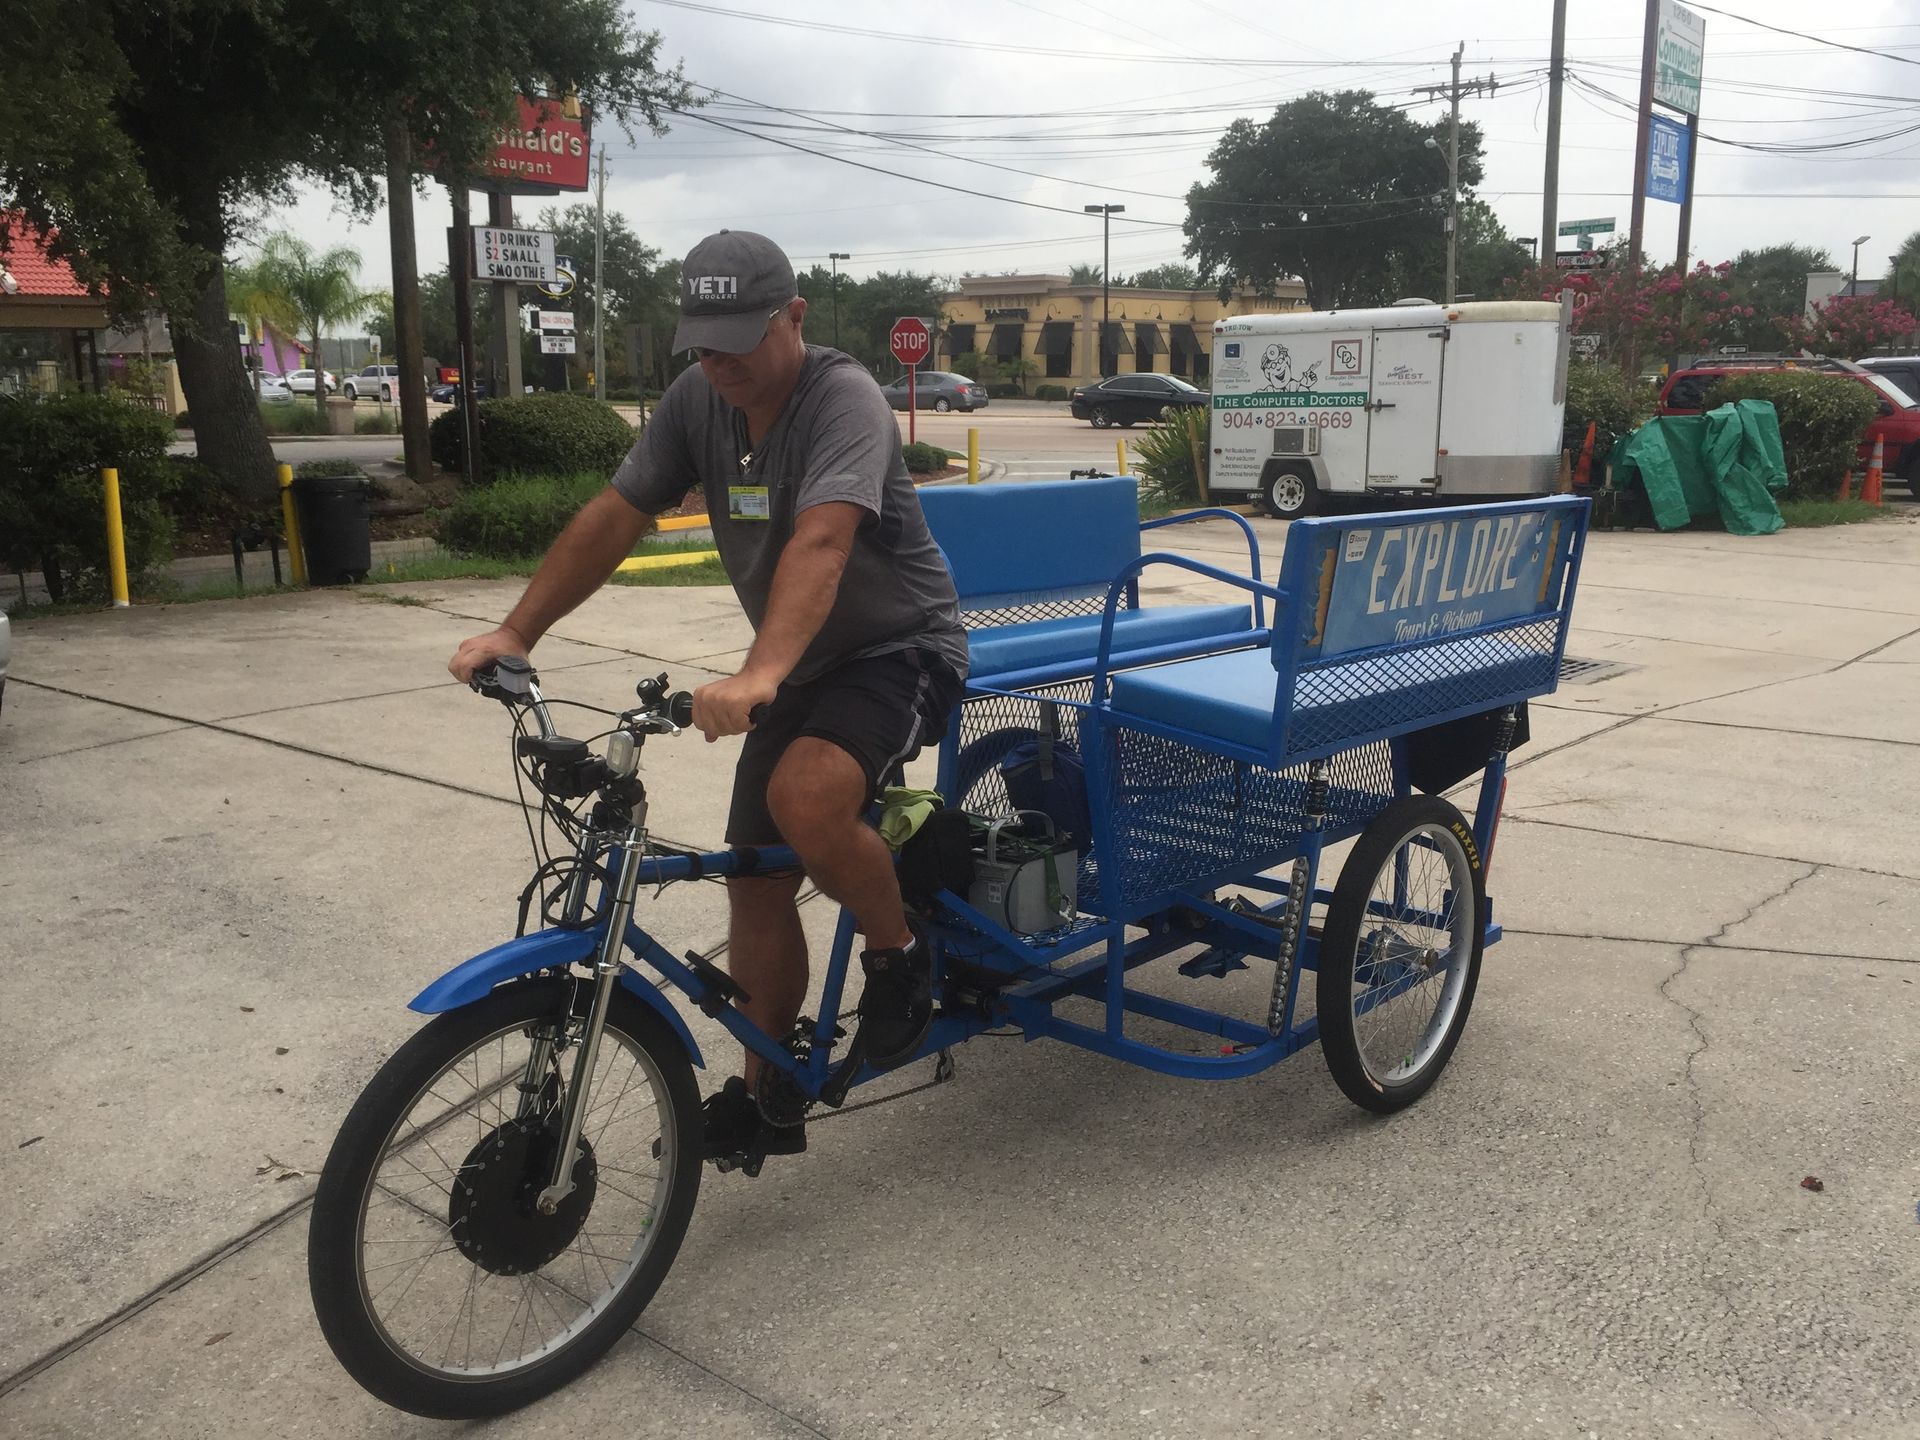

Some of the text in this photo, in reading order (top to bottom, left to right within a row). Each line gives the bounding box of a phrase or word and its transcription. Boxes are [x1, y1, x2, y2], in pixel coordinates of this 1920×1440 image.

[1658, 27, 1700, 76] Computer
[1664, 68, 1698, 112] Doctors
[500, 232, 540, 248] DRINKS
[502, 248, 540, 263] SMALL
[1558, 256, 1574, 266] ONE
[488, 263, 545, 279] SMOOTHIE
[688, 276, 737, 295] YETI
[893, 332, 927, 349] STOP
[1216, 395, 1364, 407] THE COMPUTER DOCTORS
[1367, 515, 1532, 614] EXPLORE
[1394, 618, 1426, 643] Tours
[1427, 613, 1440, 637] &
[1451, 822, 1480, 870] MAXXIS
